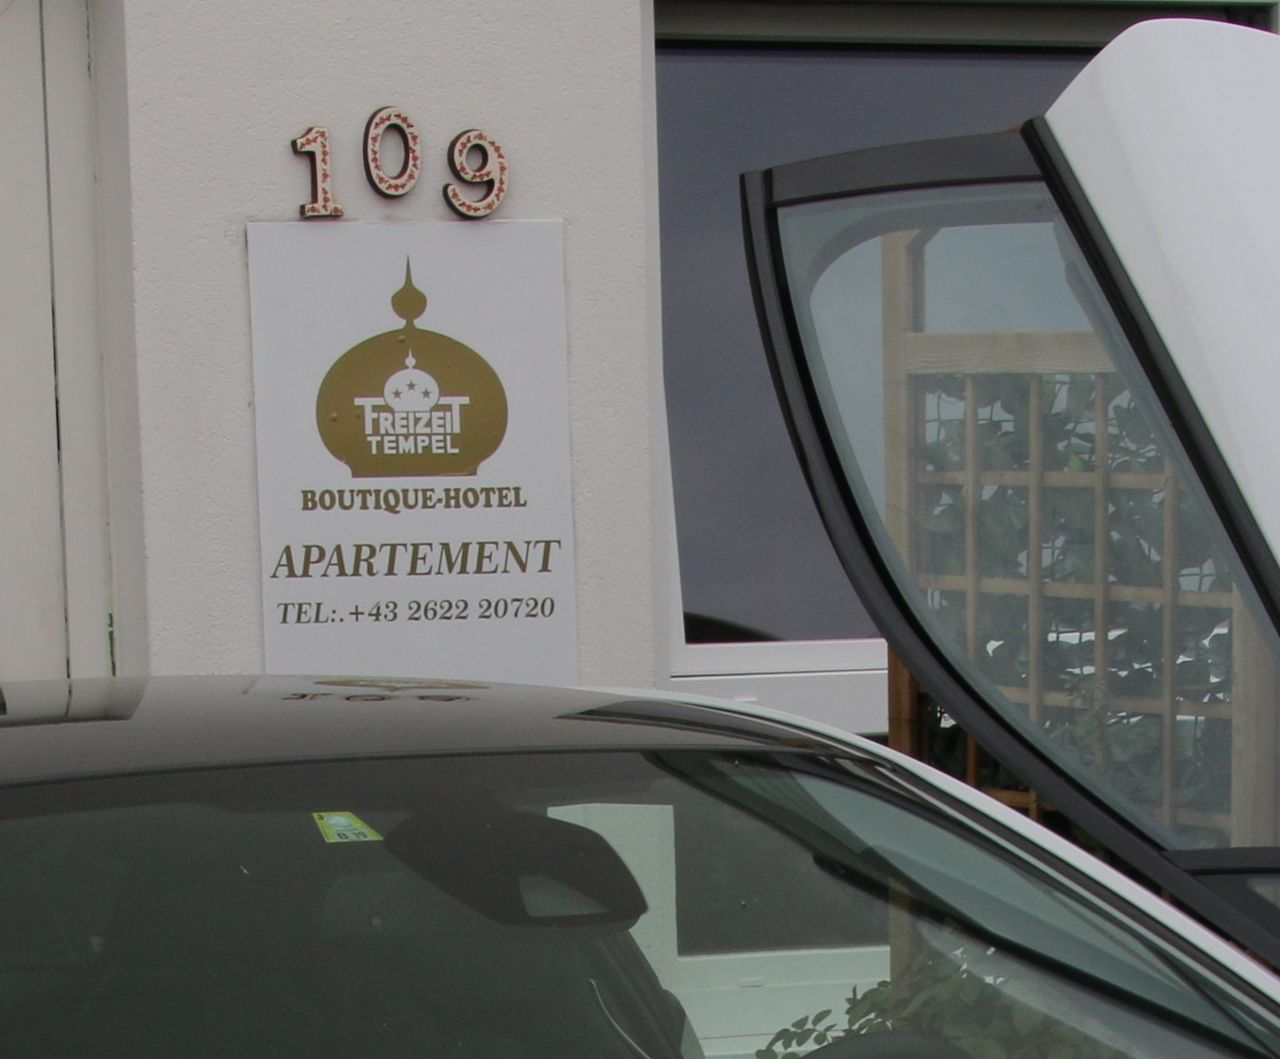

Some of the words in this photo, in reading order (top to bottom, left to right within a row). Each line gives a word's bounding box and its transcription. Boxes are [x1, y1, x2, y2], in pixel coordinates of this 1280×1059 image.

[291, 106, 508, 219] 109
[353, 396, 470, 434] FREIZEIT
[366, 435, 460, 455] TEMPEL
[301, 486, 528, 514] BOUTIQUE-HOTEL
[270, 539, 562, 579] APARTEMENT
[406, 599, 470, 621] 2622
[477, 597, 556, 620] 20720
